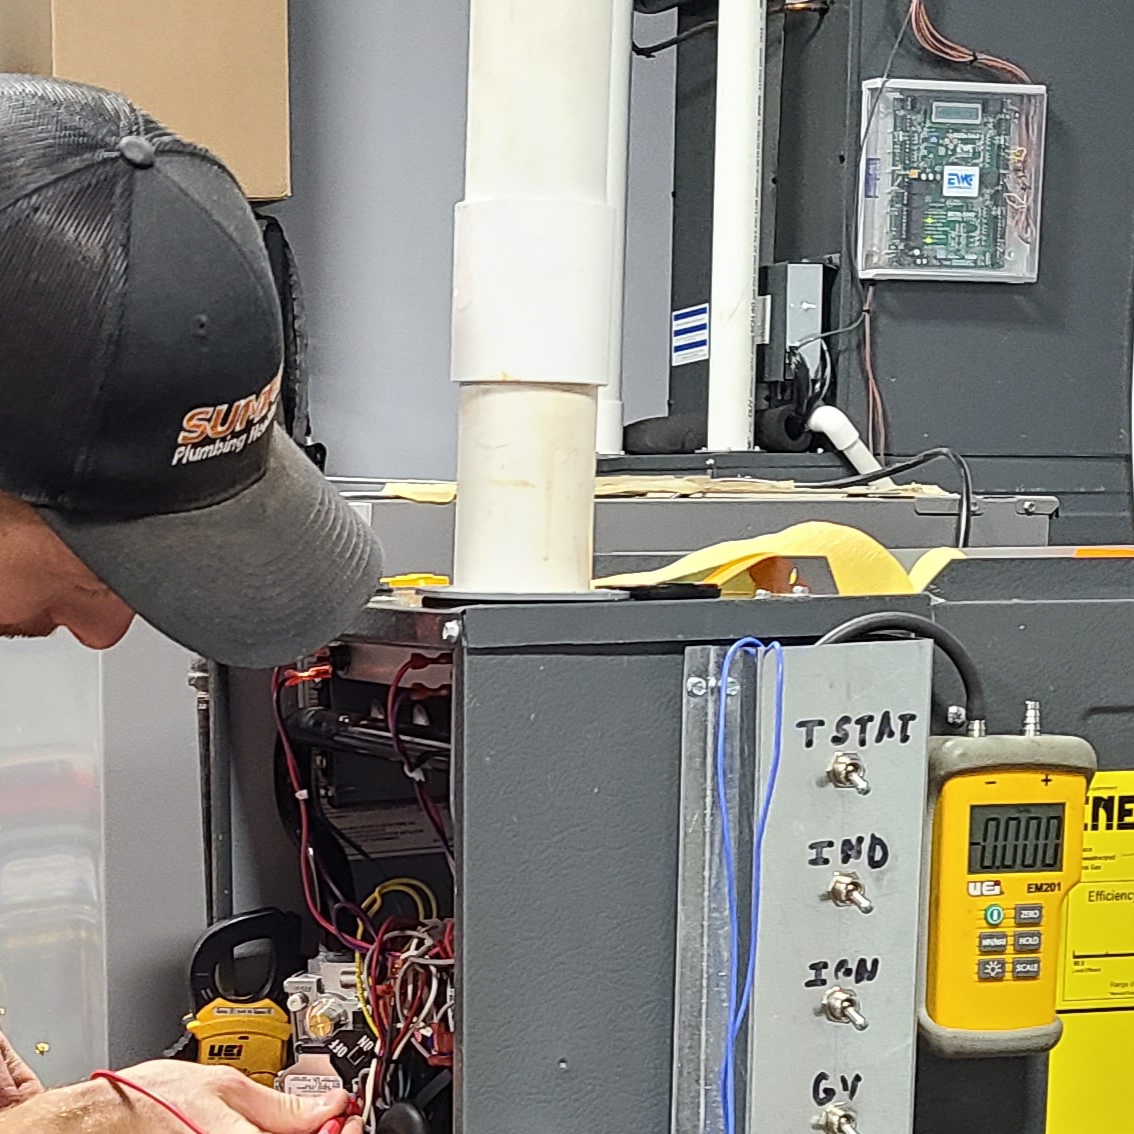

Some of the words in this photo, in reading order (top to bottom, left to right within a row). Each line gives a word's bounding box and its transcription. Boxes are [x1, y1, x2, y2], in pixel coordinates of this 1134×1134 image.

[171, 432, 248, 466] Plumbing
[808, 833, 889, 869] IND
[1026, 882, 1062, 894] EM201
[1019, 936, 1040, 945] HOLD
[1015, 963, 1039, 973] SCALE
[328, 1039, 349, 1058] OFF
[357, 1034, 375, 1052] ON
[812, 1071, 862, 1106] GV
